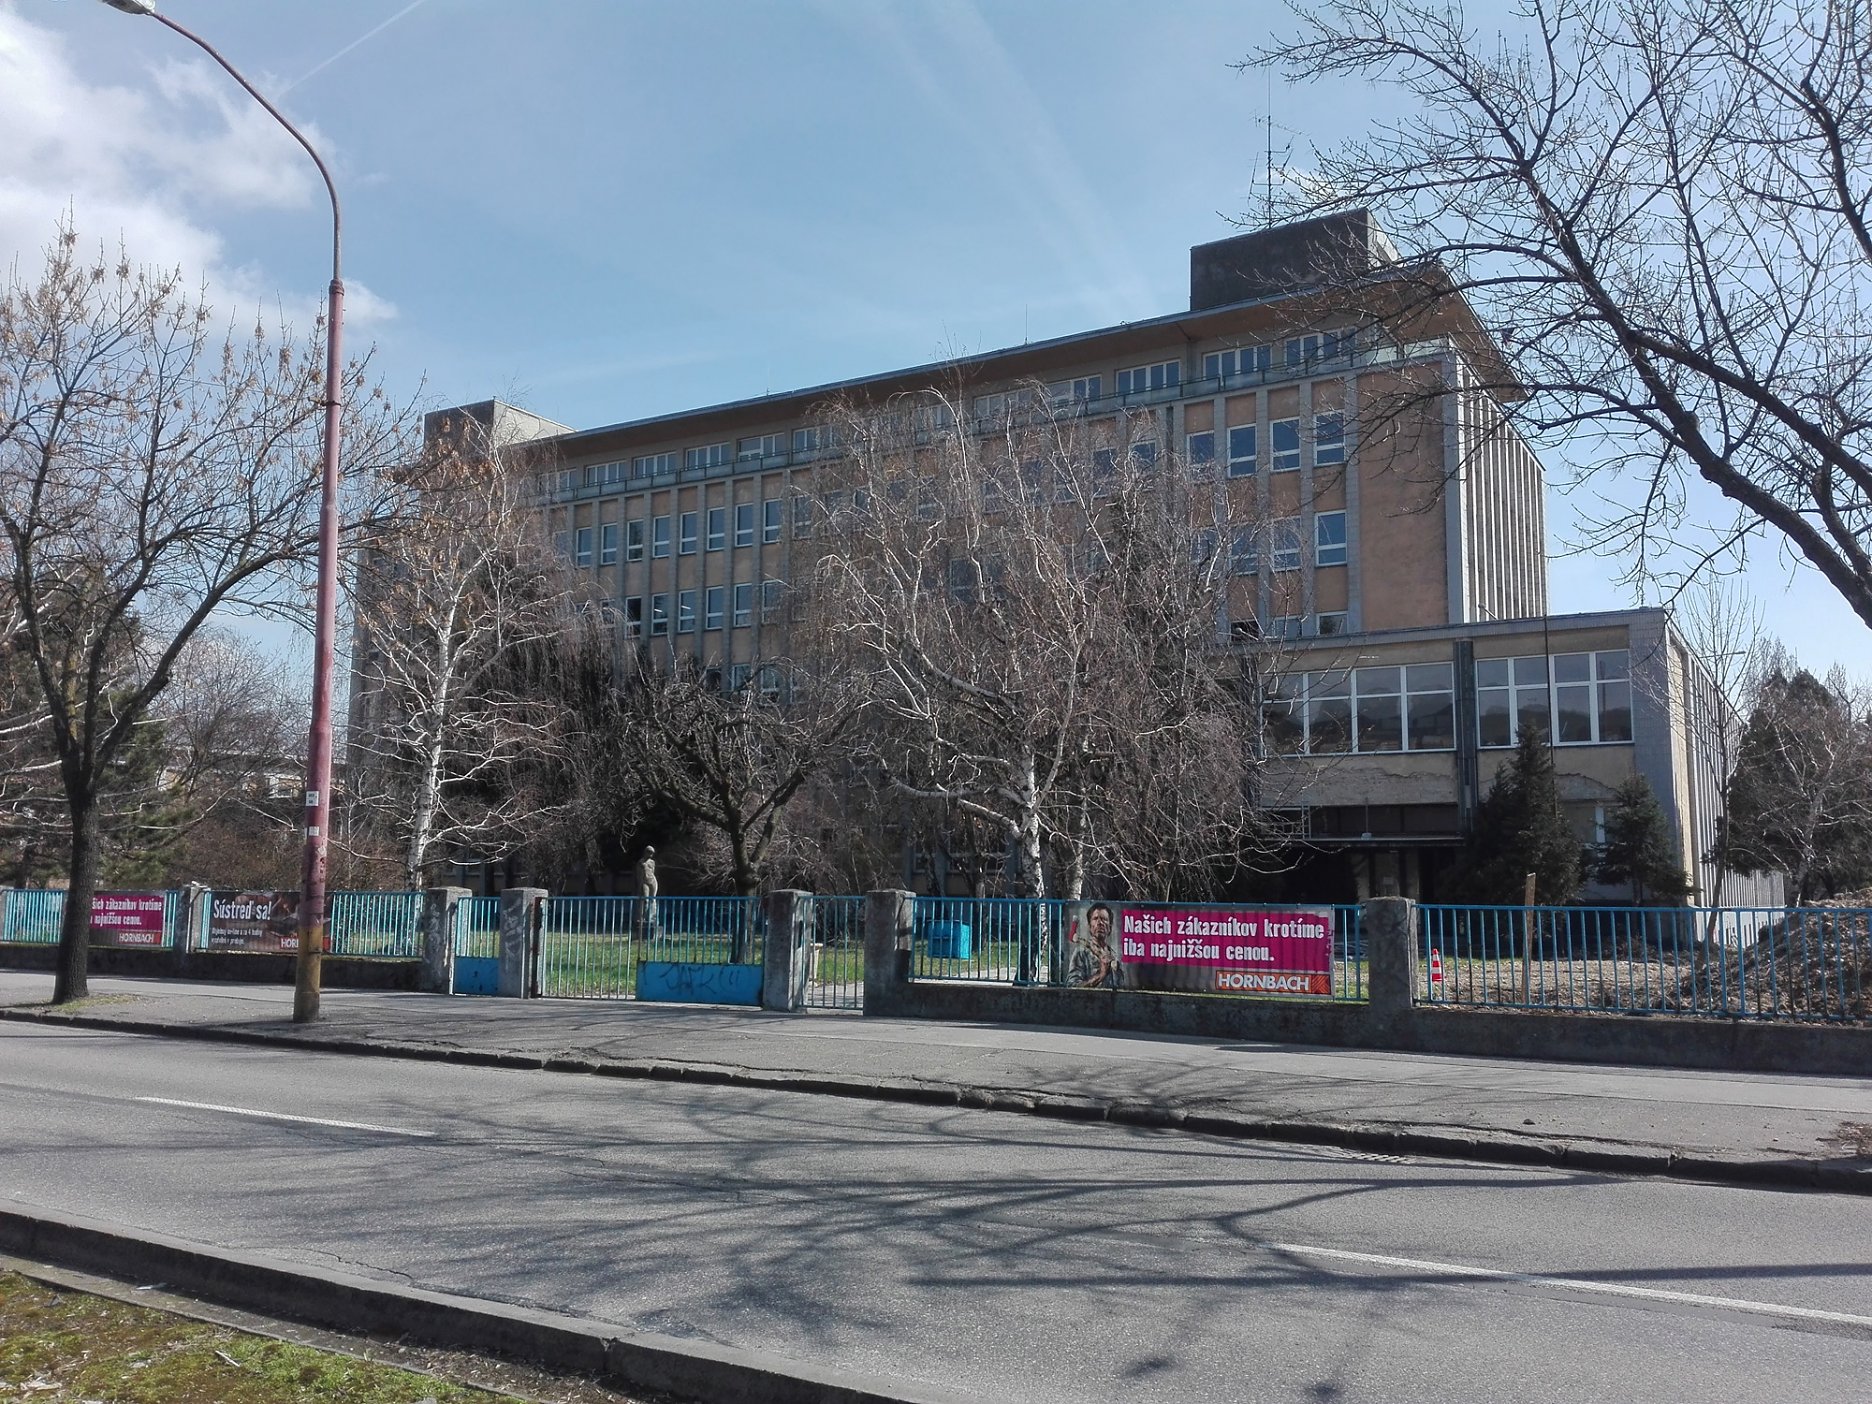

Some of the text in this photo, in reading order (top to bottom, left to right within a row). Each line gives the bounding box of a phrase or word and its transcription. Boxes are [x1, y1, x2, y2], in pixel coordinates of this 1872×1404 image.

[213, 899, 272, 920] Sústreď sa!
[1124, 914, 1324, 939] Našich zákazníkov krotíme
[119, 933, 155, 943] HORNBACH
[1123, 937, 1275, 962] iba najnižšou cenou.
[1218, 973, 1310, 991] HORNBACH
